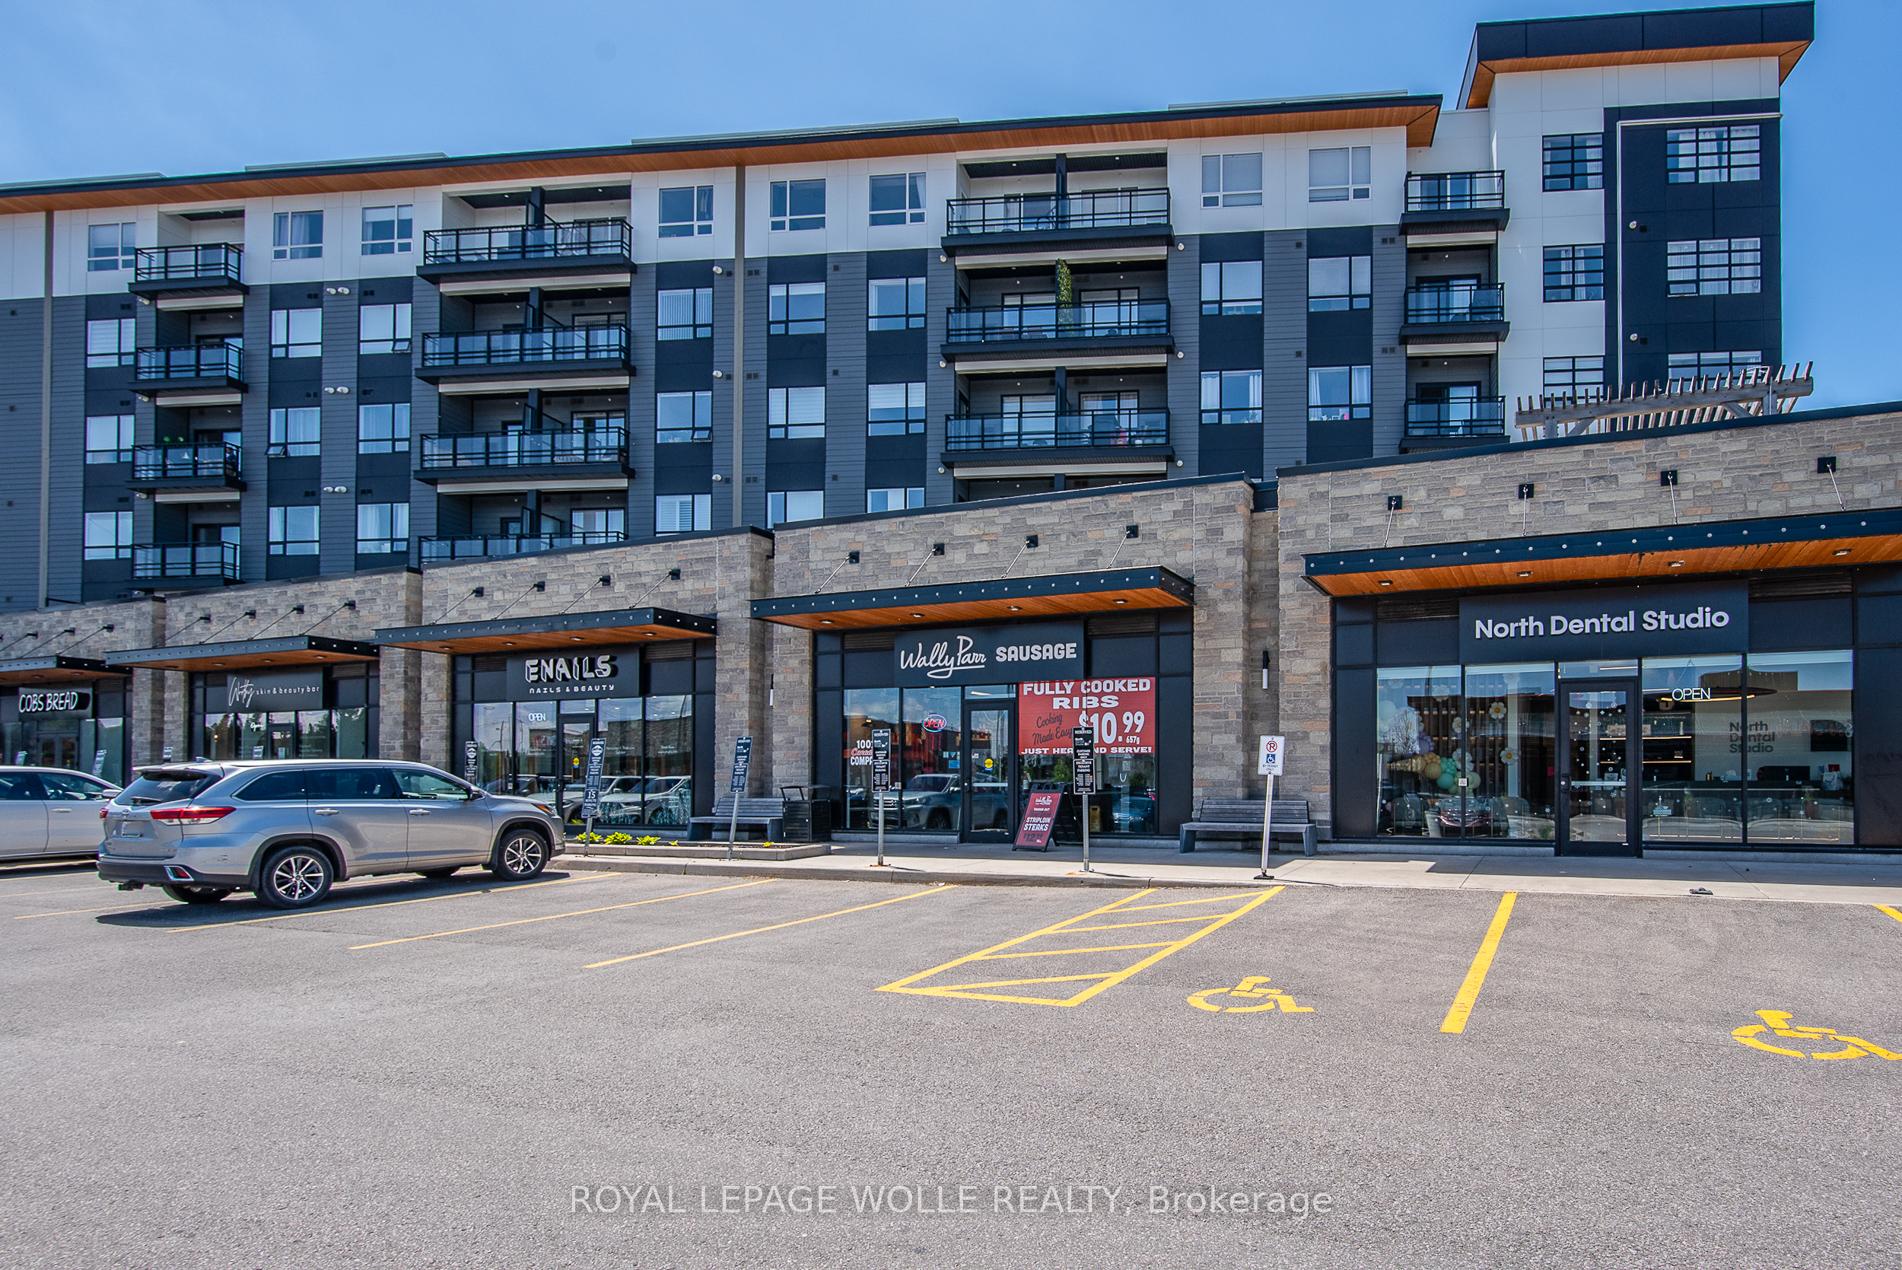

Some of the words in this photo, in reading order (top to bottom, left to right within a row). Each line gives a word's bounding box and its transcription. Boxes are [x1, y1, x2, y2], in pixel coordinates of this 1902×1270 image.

[1475, 615, 1544, 639] North
[1550, 610, 1635, 635] Dental
[1642, 606, 1730, 631] Studio
[901, 642, 955, 679] Wally
[995, 643, 1077, 662] SAUSAGE
[525, 655, 612, 683] ENAILS
[279, 685, 304, 695] beauty
[573, 684, 615, 692] BEAUTY
[1023, 681, 1075, 696] FULLY
[1080, 679, 1151, 694] COOKED
[1671, 687, 1711, 701] OPEN
[19, 693, 44, 713] COBS
[46, 691, 78, 711] BREAD
[1052, 695, 1119, 709] RIBS
[528, 712, 546, 722] OPEN
[923, 716, 946, 729] OPEN
[1729, 720, 1769, 732] Nrth
[1729, 731, 1776, 743] Dntal
[856, 739, 873, 749] 100
[1021, 747, 1050, 755] JUST
[1052, 747, 1074, 755] HEA
[1110, 746, 1152, 754] SERVE!
[588, 791, 596, 799] 15
